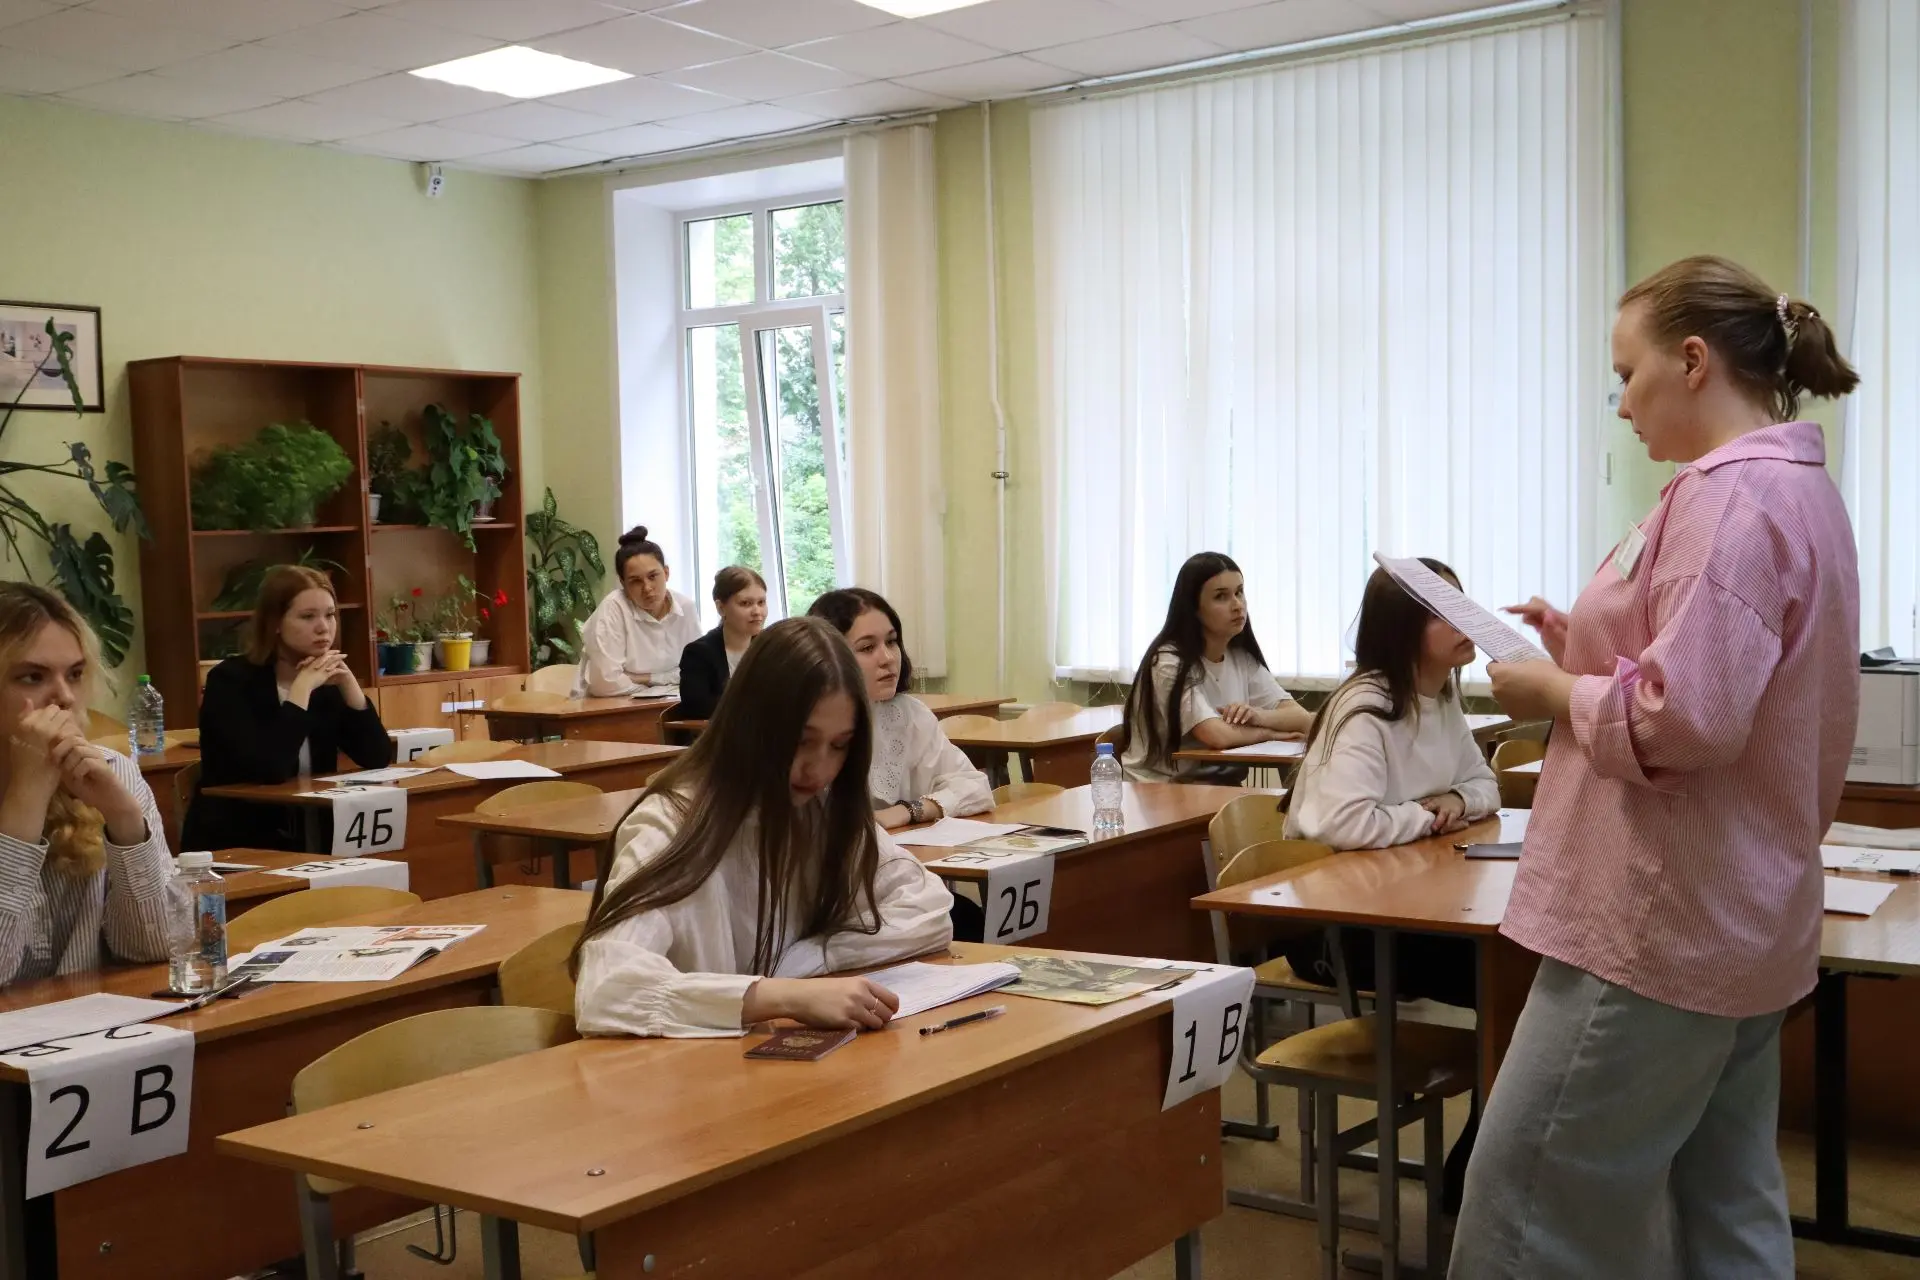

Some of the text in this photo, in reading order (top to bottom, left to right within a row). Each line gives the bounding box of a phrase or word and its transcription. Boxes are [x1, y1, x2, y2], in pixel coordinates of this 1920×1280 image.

[344, 808, 393, 849] 4Б
[997, 879, 1041, 938] 2Б
[1179, 1020, 1197, 1083] 1
[45, 1085, 91, 1160] 2
